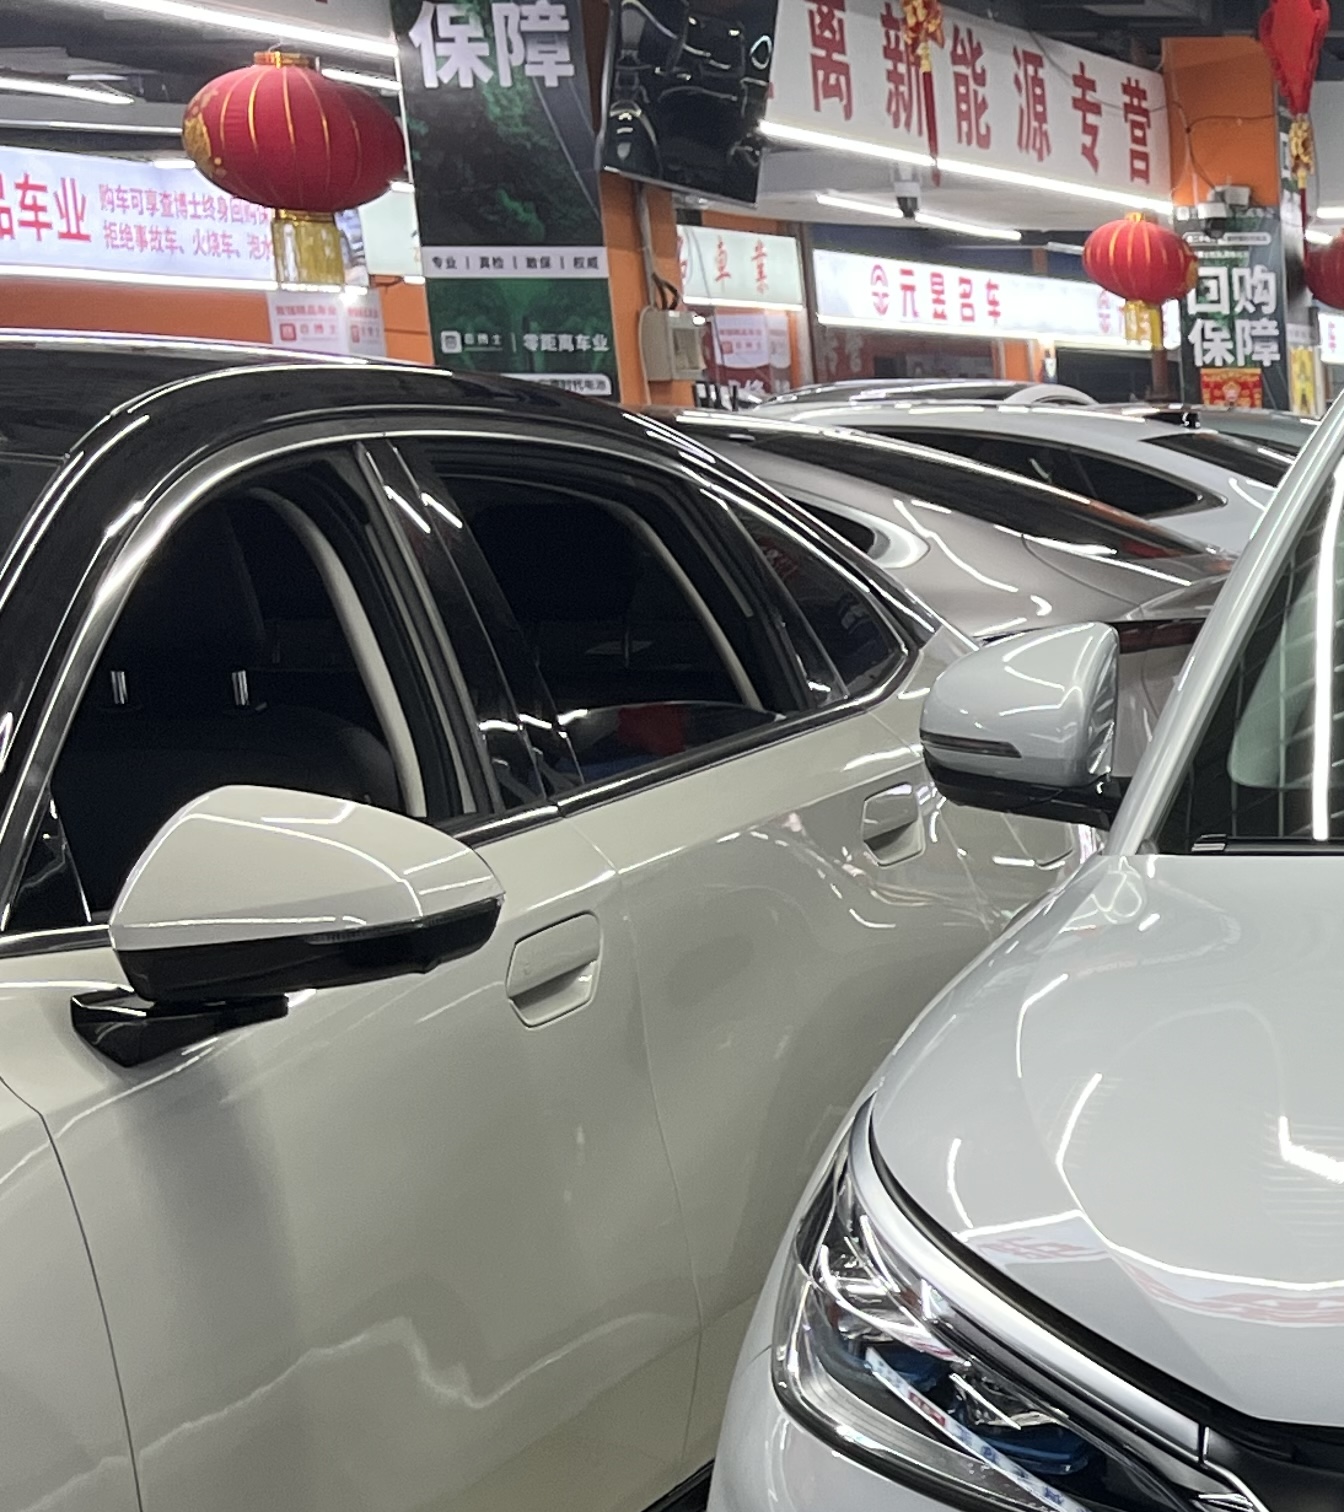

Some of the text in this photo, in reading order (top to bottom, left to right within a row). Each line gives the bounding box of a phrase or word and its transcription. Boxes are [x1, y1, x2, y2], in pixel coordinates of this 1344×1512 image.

[409, 1, 575, 88] 保障
[1187, 264, 1277, 315] 回购
[1188, 317, 1281, 368] 保障
